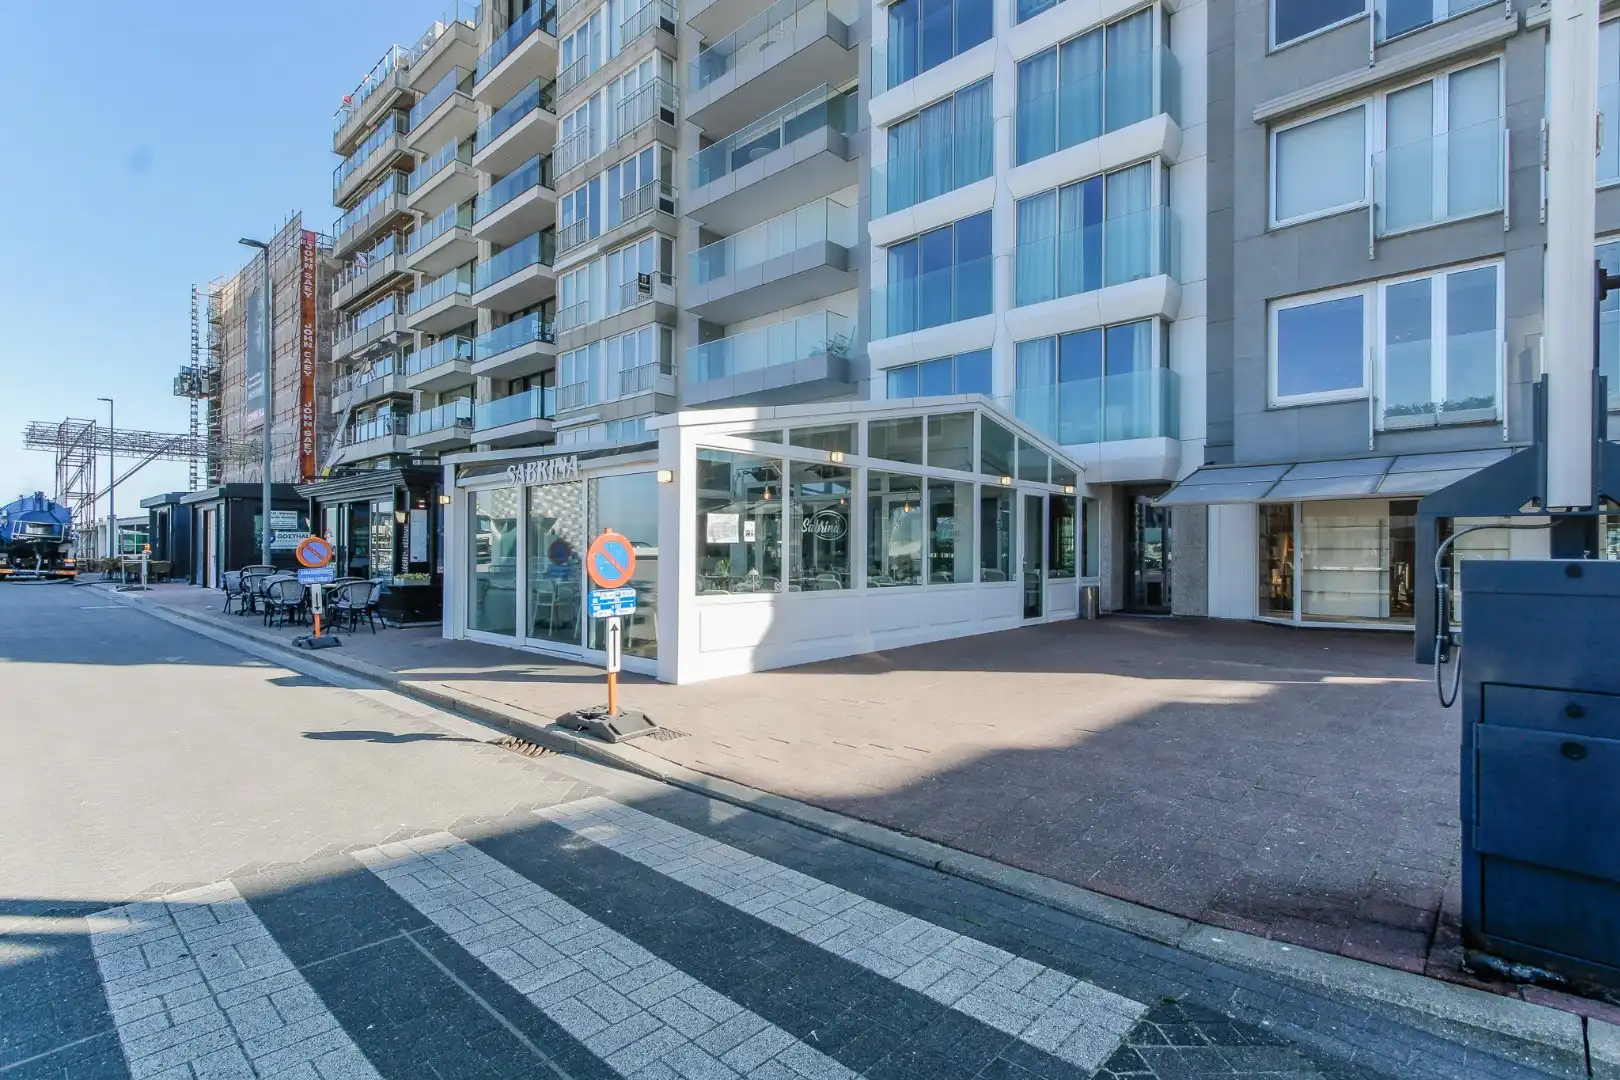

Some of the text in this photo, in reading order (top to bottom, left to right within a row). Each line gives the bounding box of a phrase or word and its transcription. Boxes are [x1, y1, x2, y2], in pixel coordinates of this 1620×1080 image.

[304, 243, 313, 270] JOHN
[304, 322, 313, 348] JOHN
[303, 401, 313, 456] JOHN SAEY
[506, 455, 579, 486] SABRINA
[801, 517, 841, 534] Sabrina
